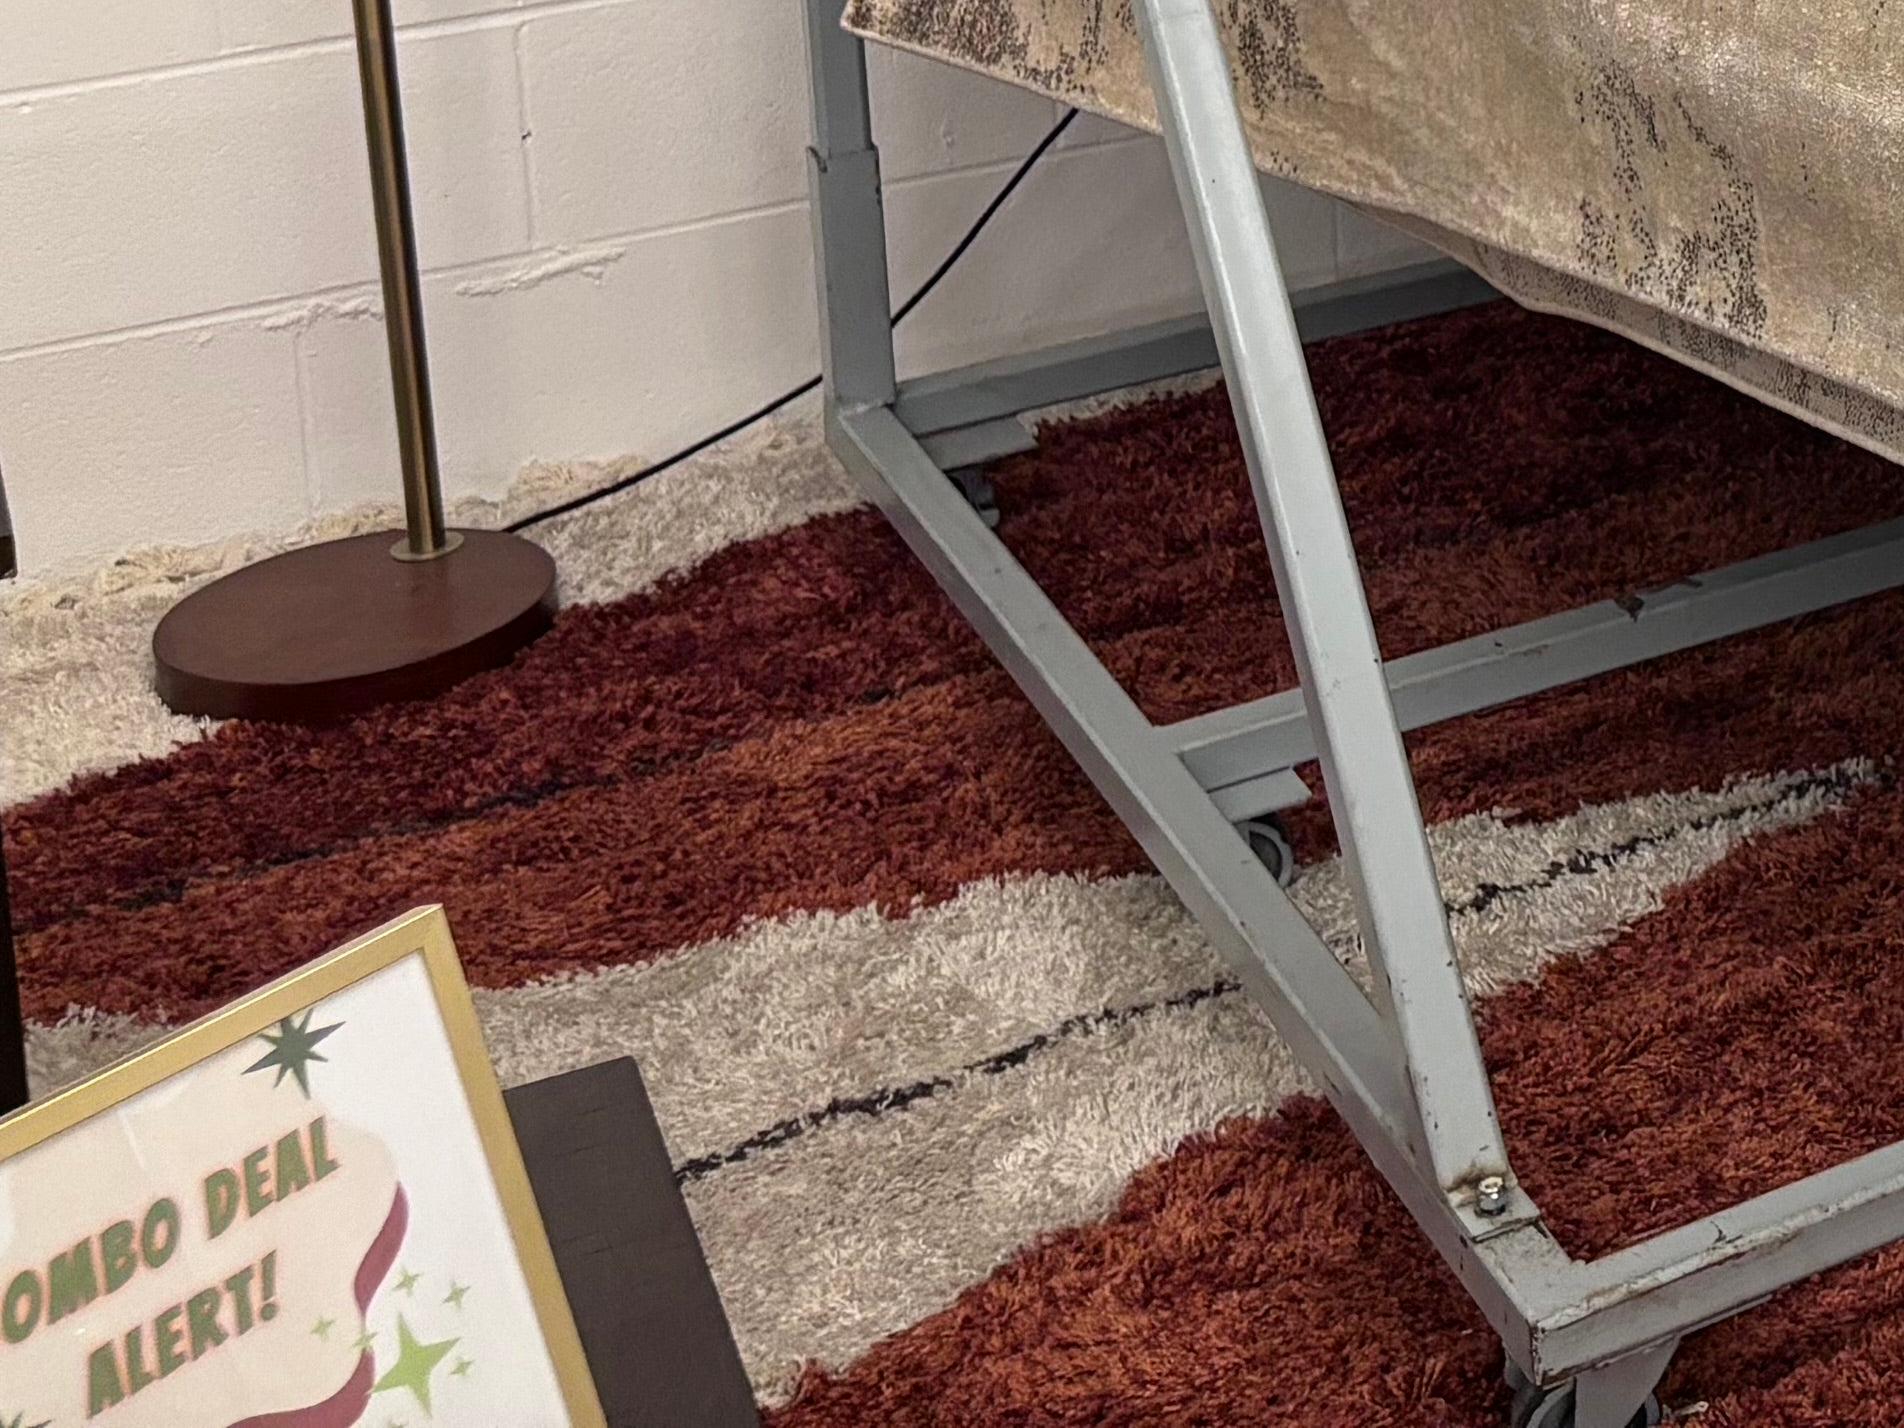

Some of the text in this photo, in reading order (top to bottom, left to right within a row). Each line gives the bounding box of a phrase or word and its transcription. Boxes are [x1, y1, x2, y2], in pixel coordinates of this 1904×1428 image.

[1, 1115, 341, 1344] OMBO DEAL
[87, 1249, 279, 1420] ALERT!
